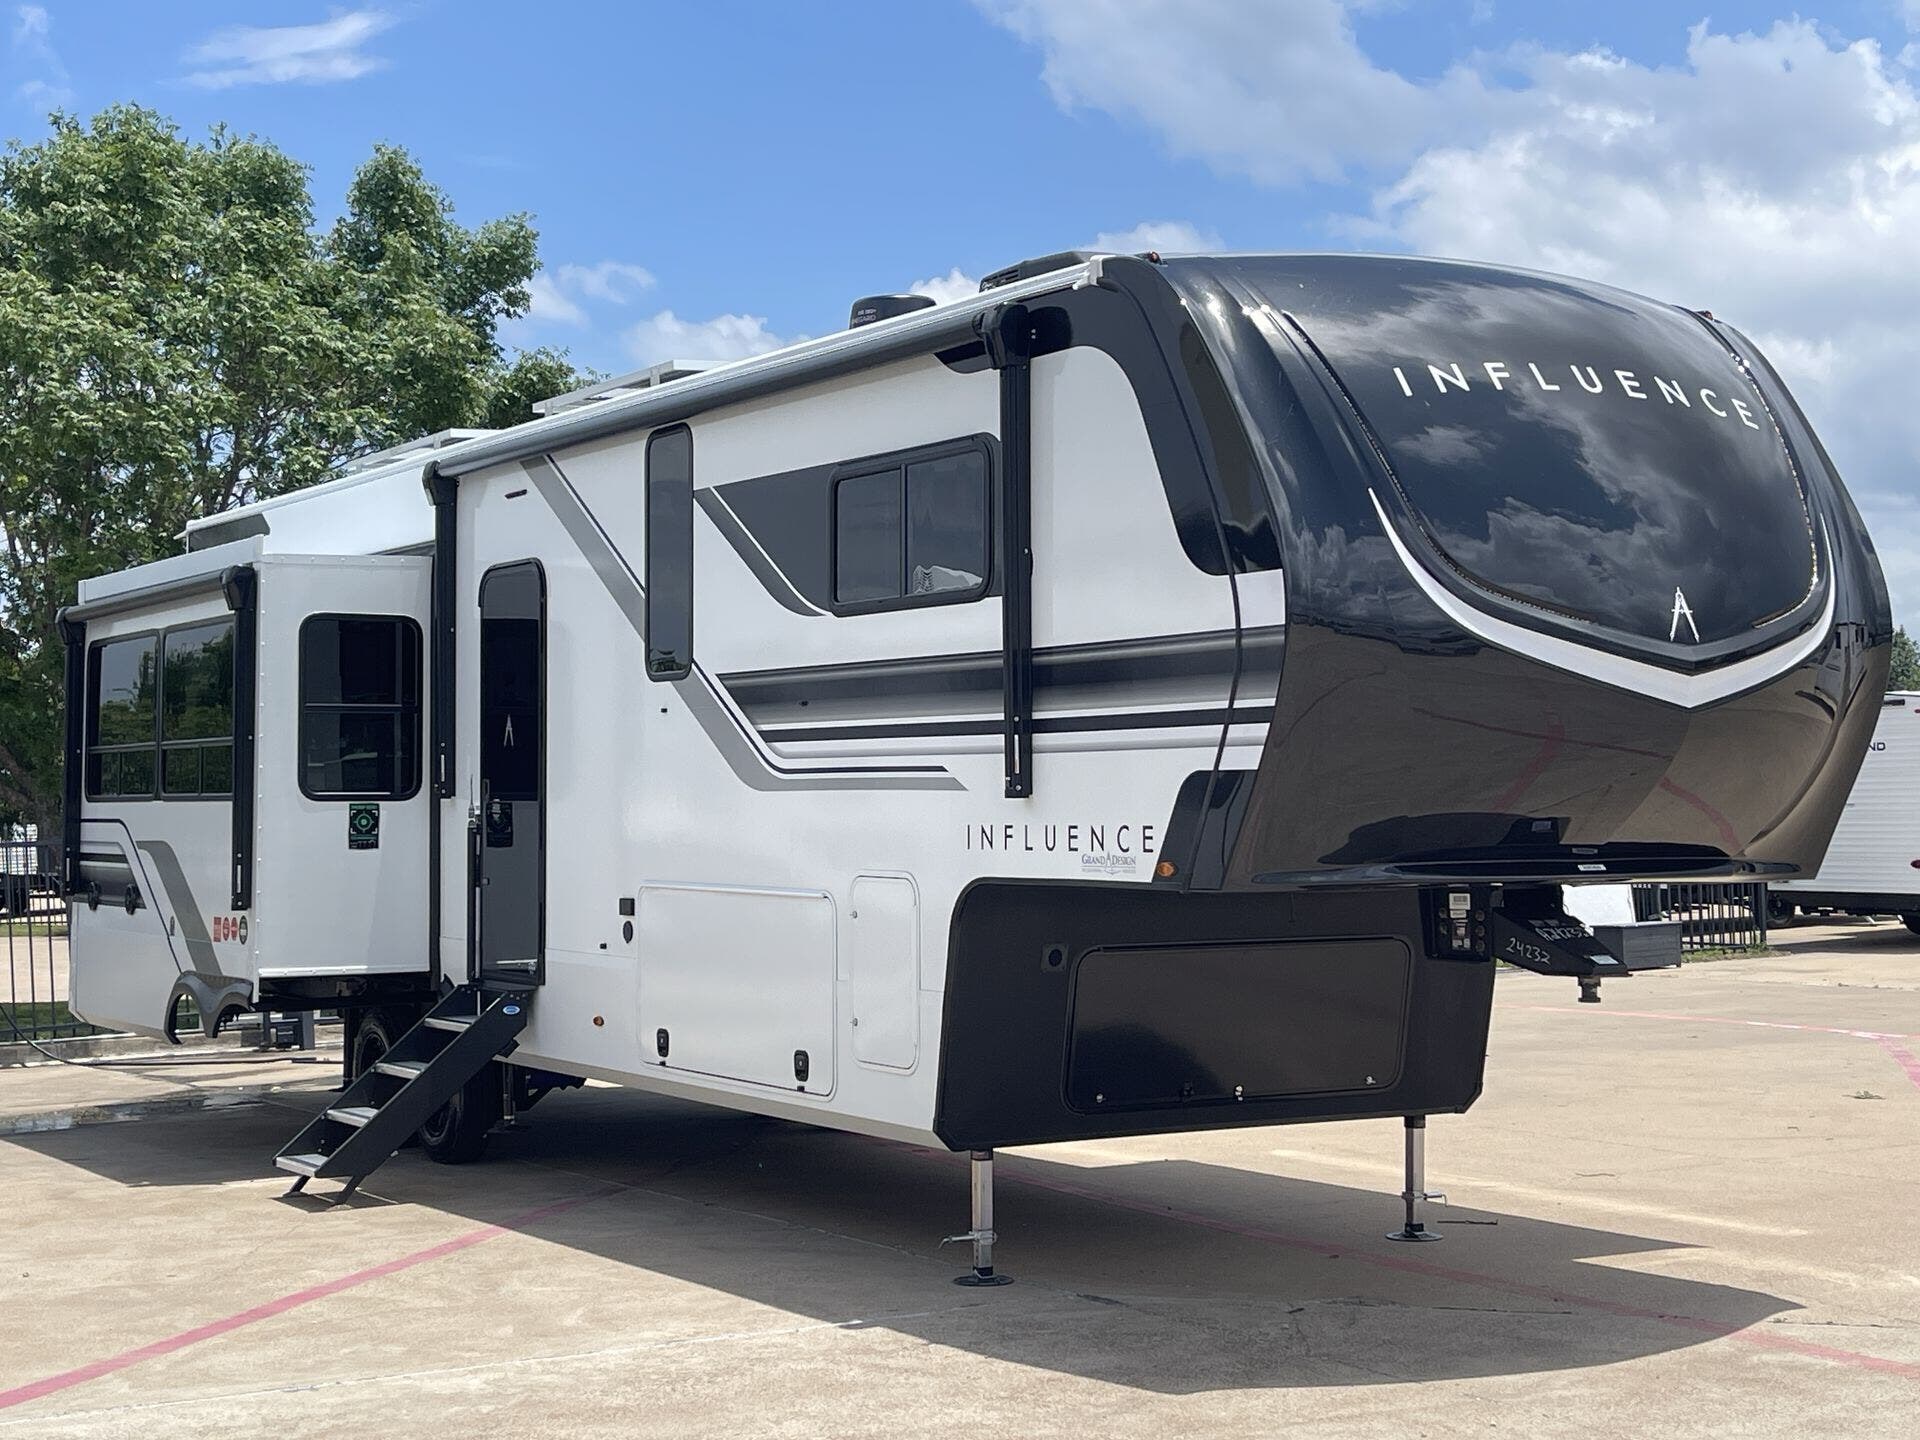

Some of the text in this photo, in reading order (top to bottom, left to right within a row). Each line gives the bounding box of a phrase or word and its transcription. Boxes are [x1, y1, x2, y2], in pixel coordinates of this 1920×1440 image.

[1393, 362, 1760, 430] INFLUENCE
[967, 824, 1154, 853] INFLUENCE
[1505, 937, 1552, 966] 24232
